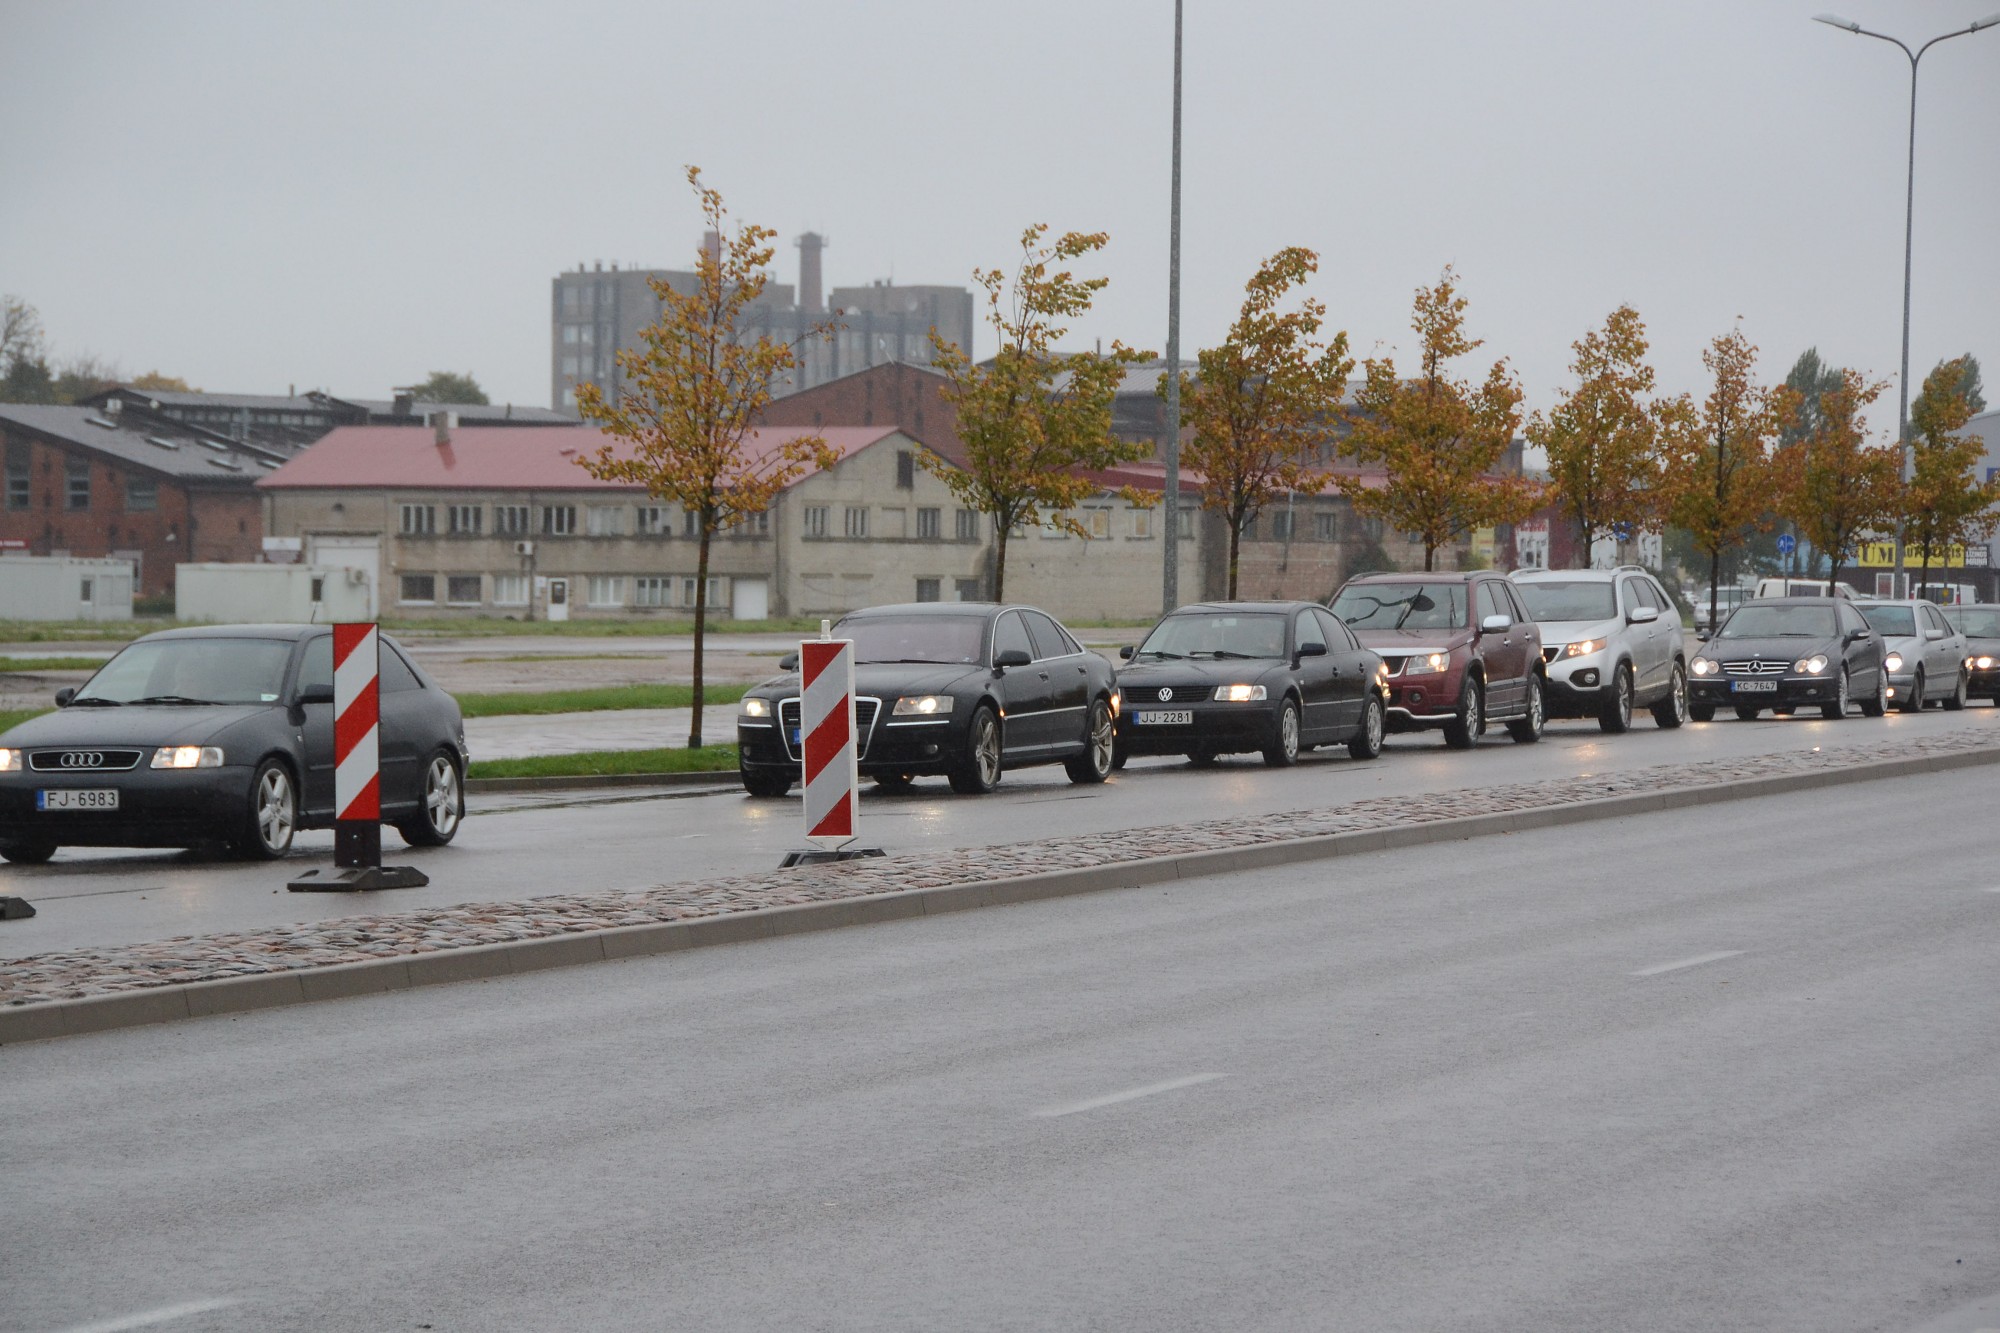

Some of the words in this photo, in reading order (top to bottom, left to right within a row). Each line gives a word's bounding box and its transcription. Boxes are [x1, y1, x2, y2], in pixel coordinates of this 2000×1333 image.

[1737, 682, 1776, 690] KC-7647
[1141, 712, 1189, 723] JJ-2281
[47, 792, 116, 807] FJ-6983
